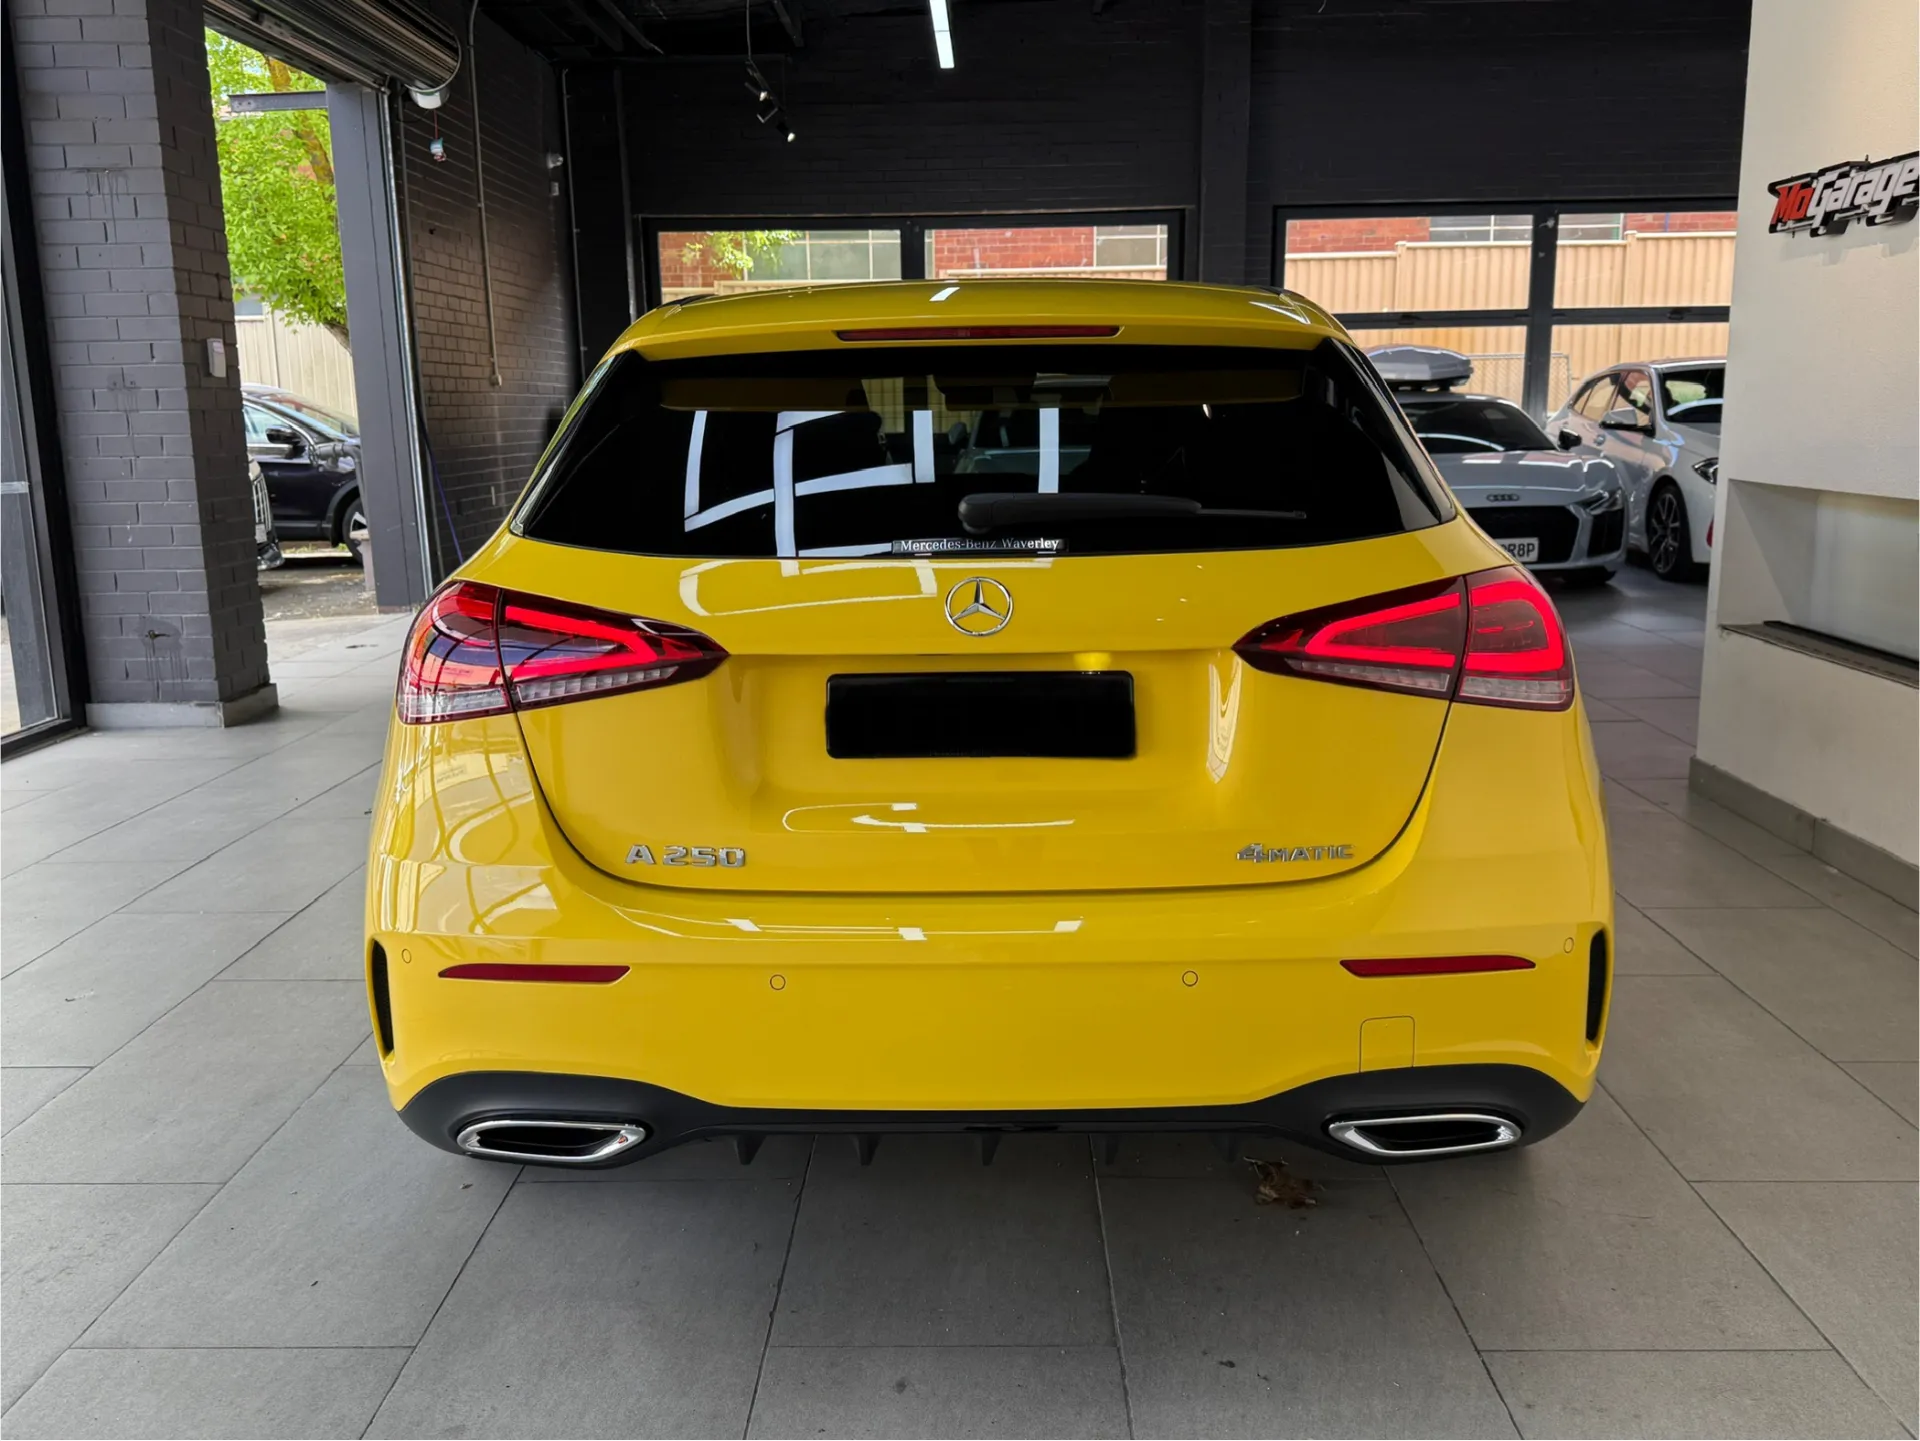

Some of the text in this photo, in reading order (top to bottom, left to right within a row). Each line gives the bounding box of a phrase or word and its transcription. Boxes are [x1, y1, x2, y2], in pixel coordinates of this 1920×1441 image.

[900, 537, 1060, 551] Mercedes-Benz Waverley
[625, 845, 746, 868] A 250
[1236, 843, 1355, 863] 4MATIC
